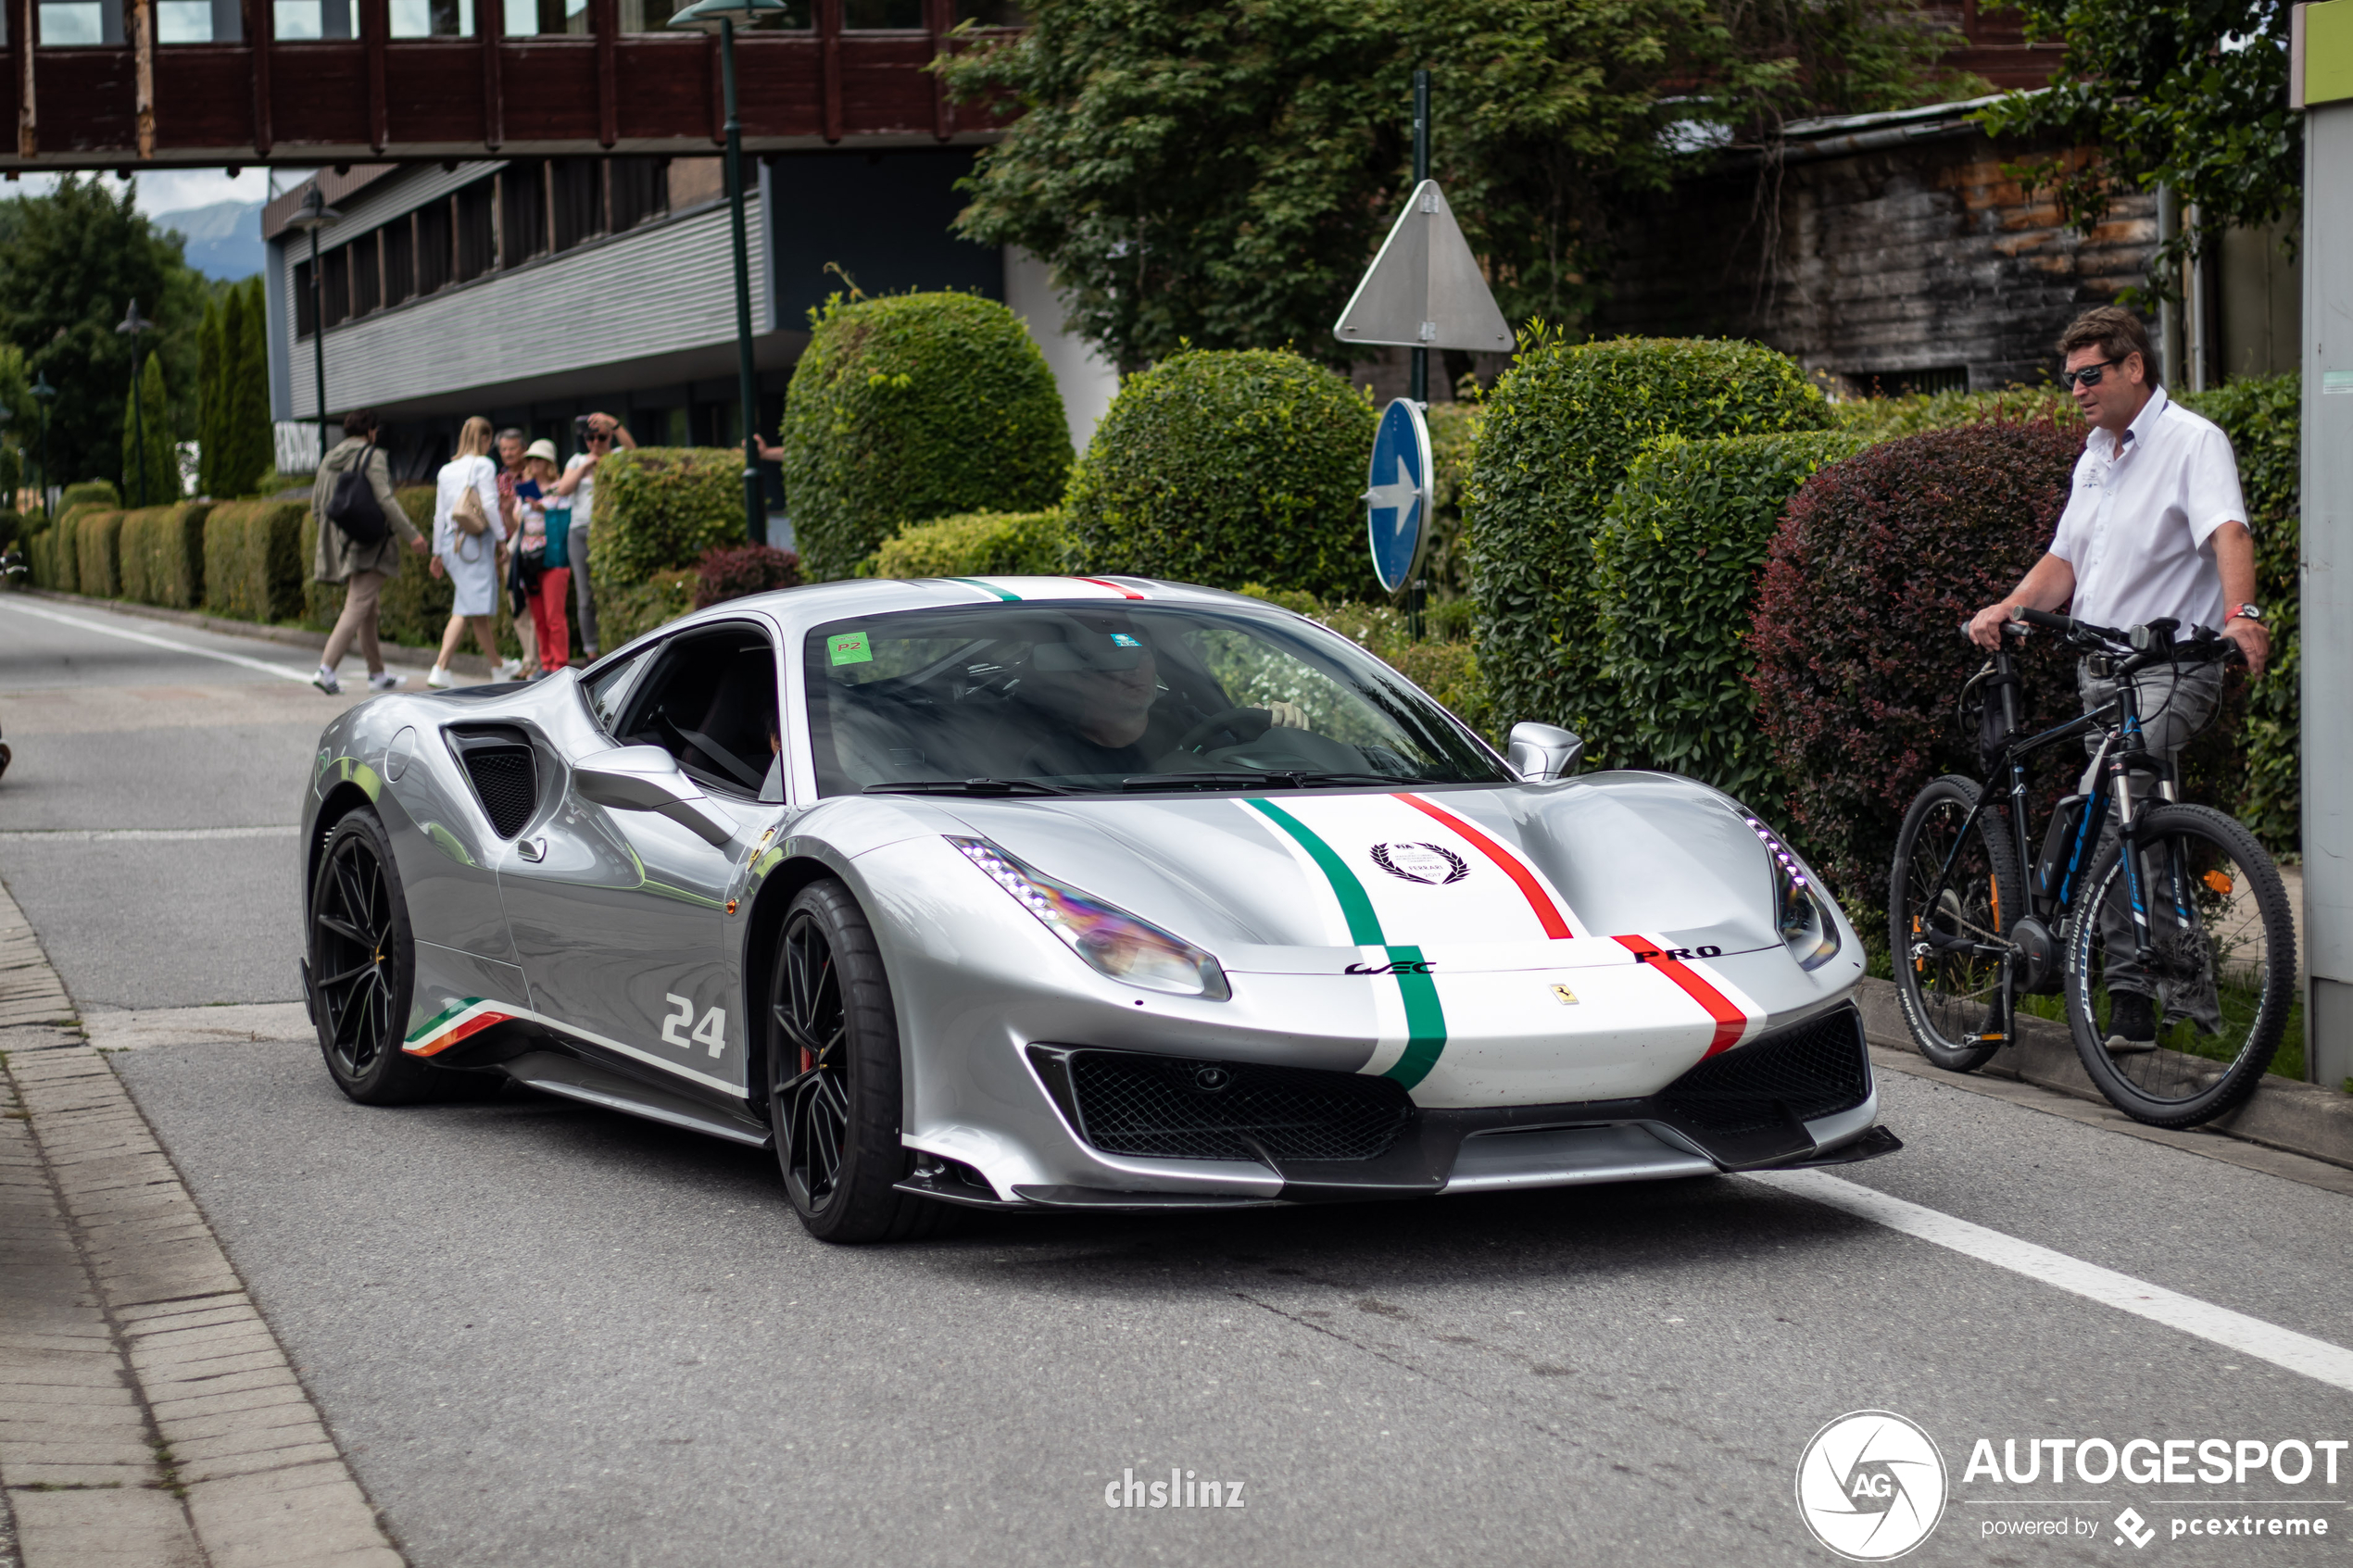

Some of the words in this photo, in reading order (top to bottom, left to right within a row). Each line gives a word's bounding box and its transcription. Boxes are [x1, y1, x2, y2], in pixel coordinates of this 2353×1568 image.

[837, 642, 862, 652] P2
[1408, 864, 1444, 872] FERRARI
[2069, 882, 2096, 974] SCHWALBE
[1344, 961, 1437, 975] WEC
[1634, 945, 1722, 964] PRO
[1901, 987, 1919, 1026] RAPID
[661, 992, 726, 1060] 24
